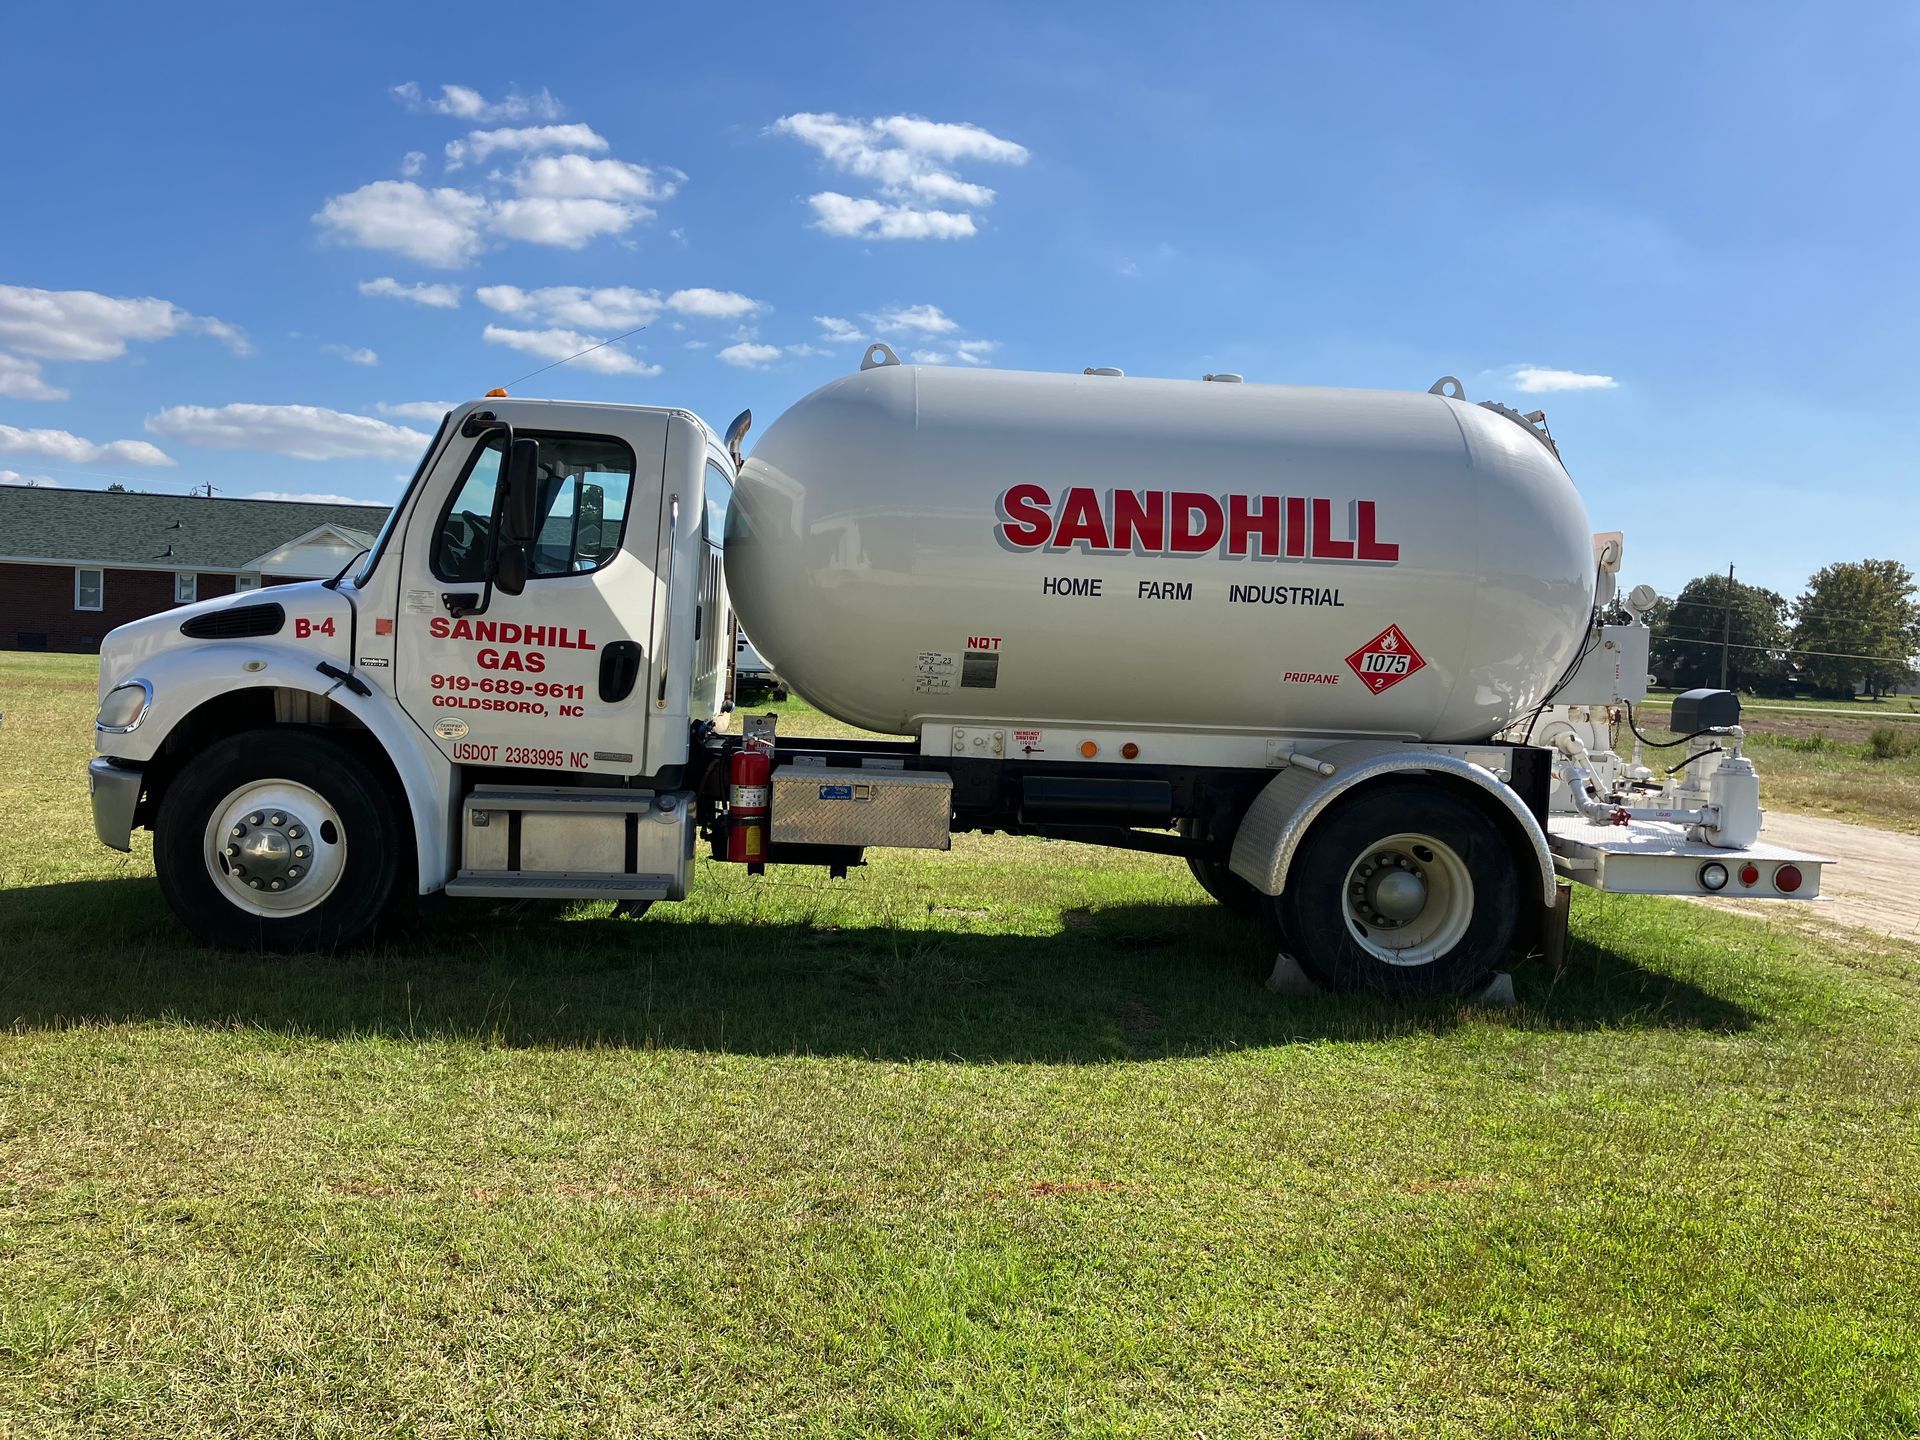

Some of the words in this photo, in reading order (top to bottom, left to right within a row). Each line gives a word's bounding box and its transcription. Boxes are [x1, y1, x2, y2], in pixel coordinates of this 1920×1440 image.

[1000, 483, 1400, 564] SANDHILL
[1043, 576, 1103, 597] HOME
[1138, 580, 1193, 601] FARM
[1229, 584, 1345, 607] INDUSTRIAL
[295, 616, 336, 639] B-4
[429, 617, 596, 651] SANDHILL
[967, 636, 1002, 650] NQT
[477, 648, 546, 673] GAS
[1366, 654, 1408, 674] 1075
[430, 674, 584, 700] 919-689-9611
[1283, 672, 1340, 685] PROPANE
[1374, 678, 1385, 688] 2
[432, 695, 549, 718] GOLDSBORO,
[559, 704, 585, 718] NC
[453, 742, 499, 762] USDOT
[505, 746, 564, 767] 2383995
[570, 751, 589, 769] NC
